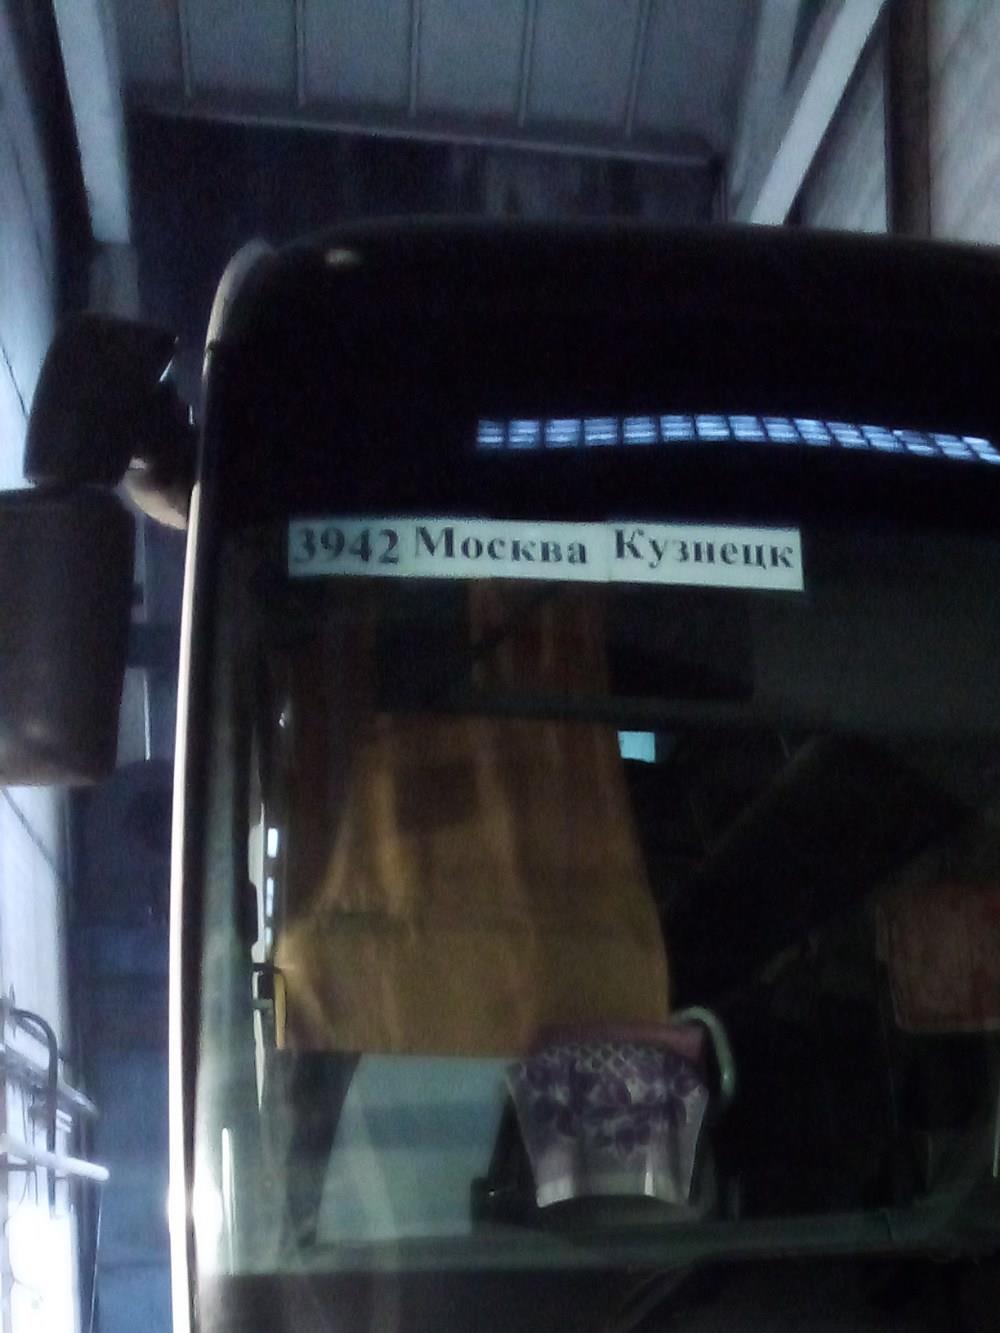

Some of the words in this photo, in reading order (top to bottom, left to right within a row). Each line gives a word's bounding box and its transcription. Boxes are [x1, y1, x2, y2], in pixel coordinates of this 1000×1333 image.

[292, 525, 400, 565] 3942
[414, 526, 588, 565] Москва
[615, 528, 796, 569] Кузнецк
